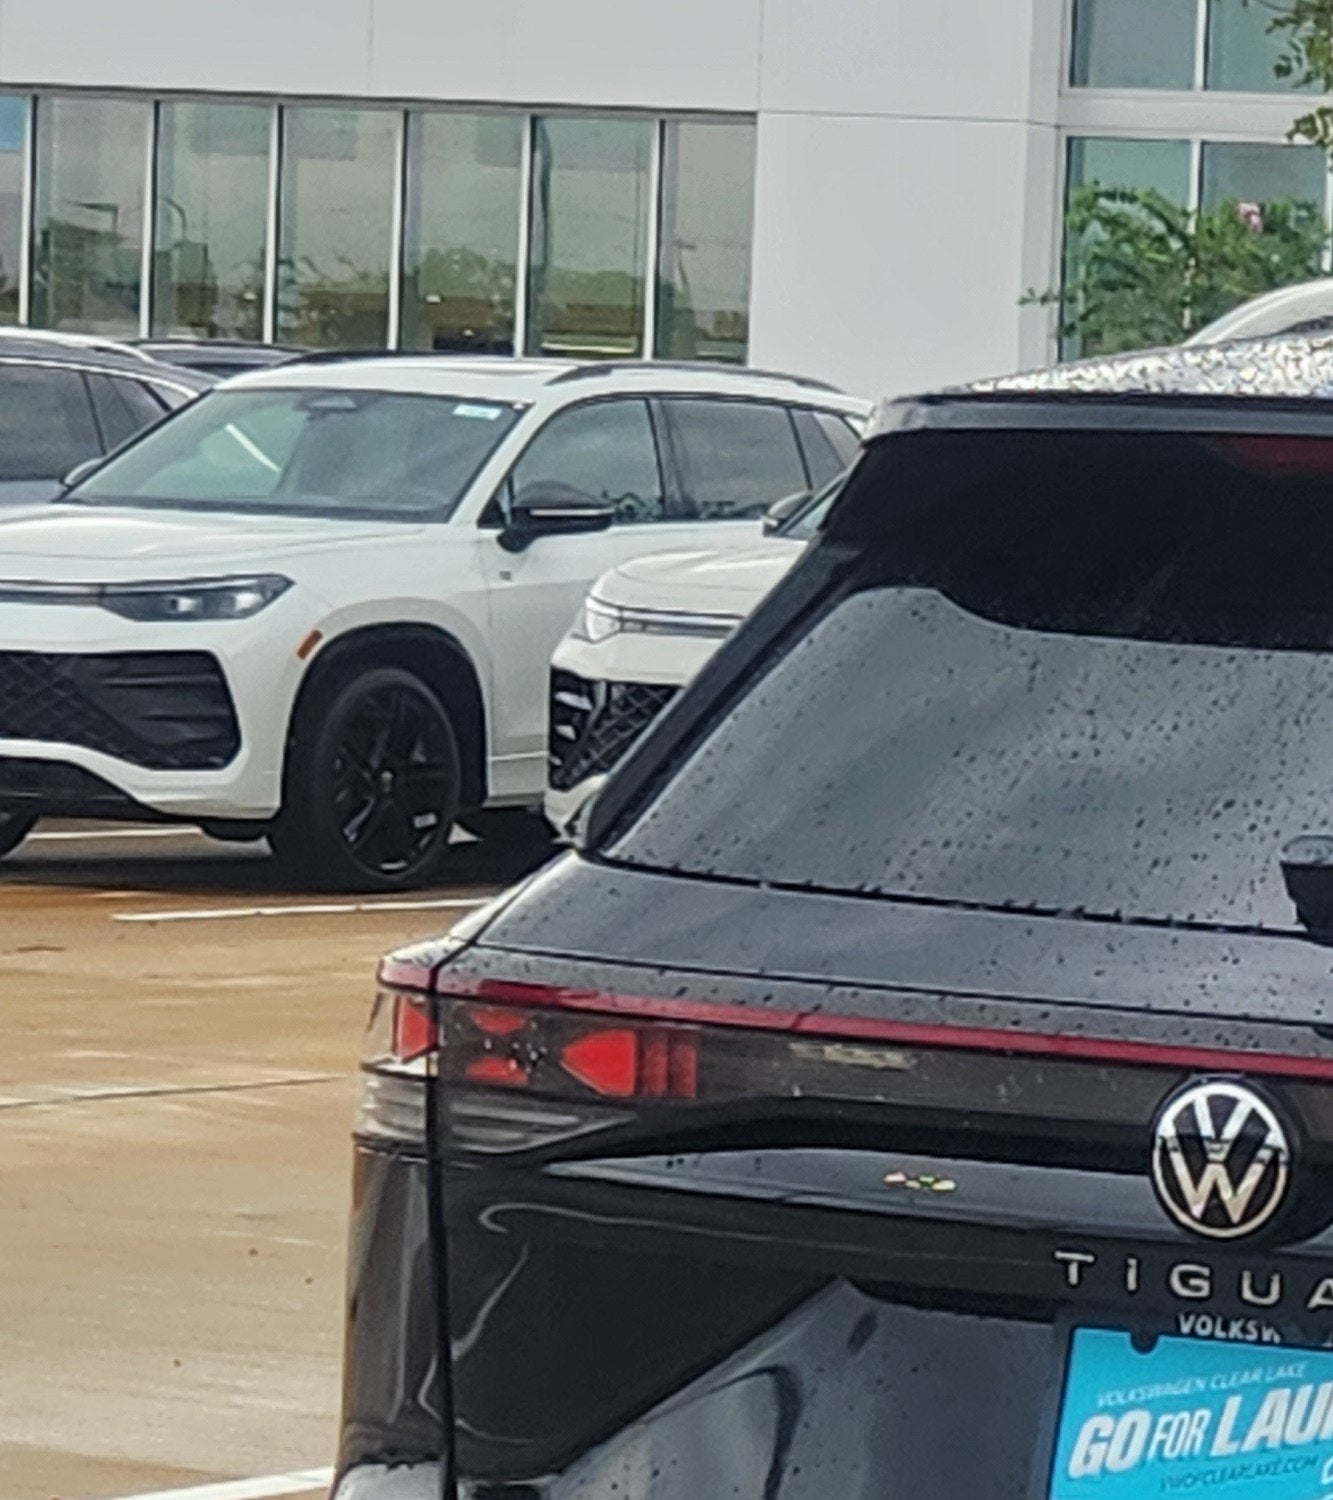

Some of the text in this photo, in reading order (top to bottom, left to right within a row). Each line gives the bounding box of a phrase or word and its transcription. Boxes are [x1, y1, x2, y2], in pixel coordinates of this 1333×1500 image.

[1152, 1082, 1290, 1239] VW
[1209, 1370, 1262, 1393] CLEAR
[1264, 1360, 1310, 1381] LAKE
[1067, 1408, 1152, 1479] GO
[1147, 1408, 1212, 1461] FOR
